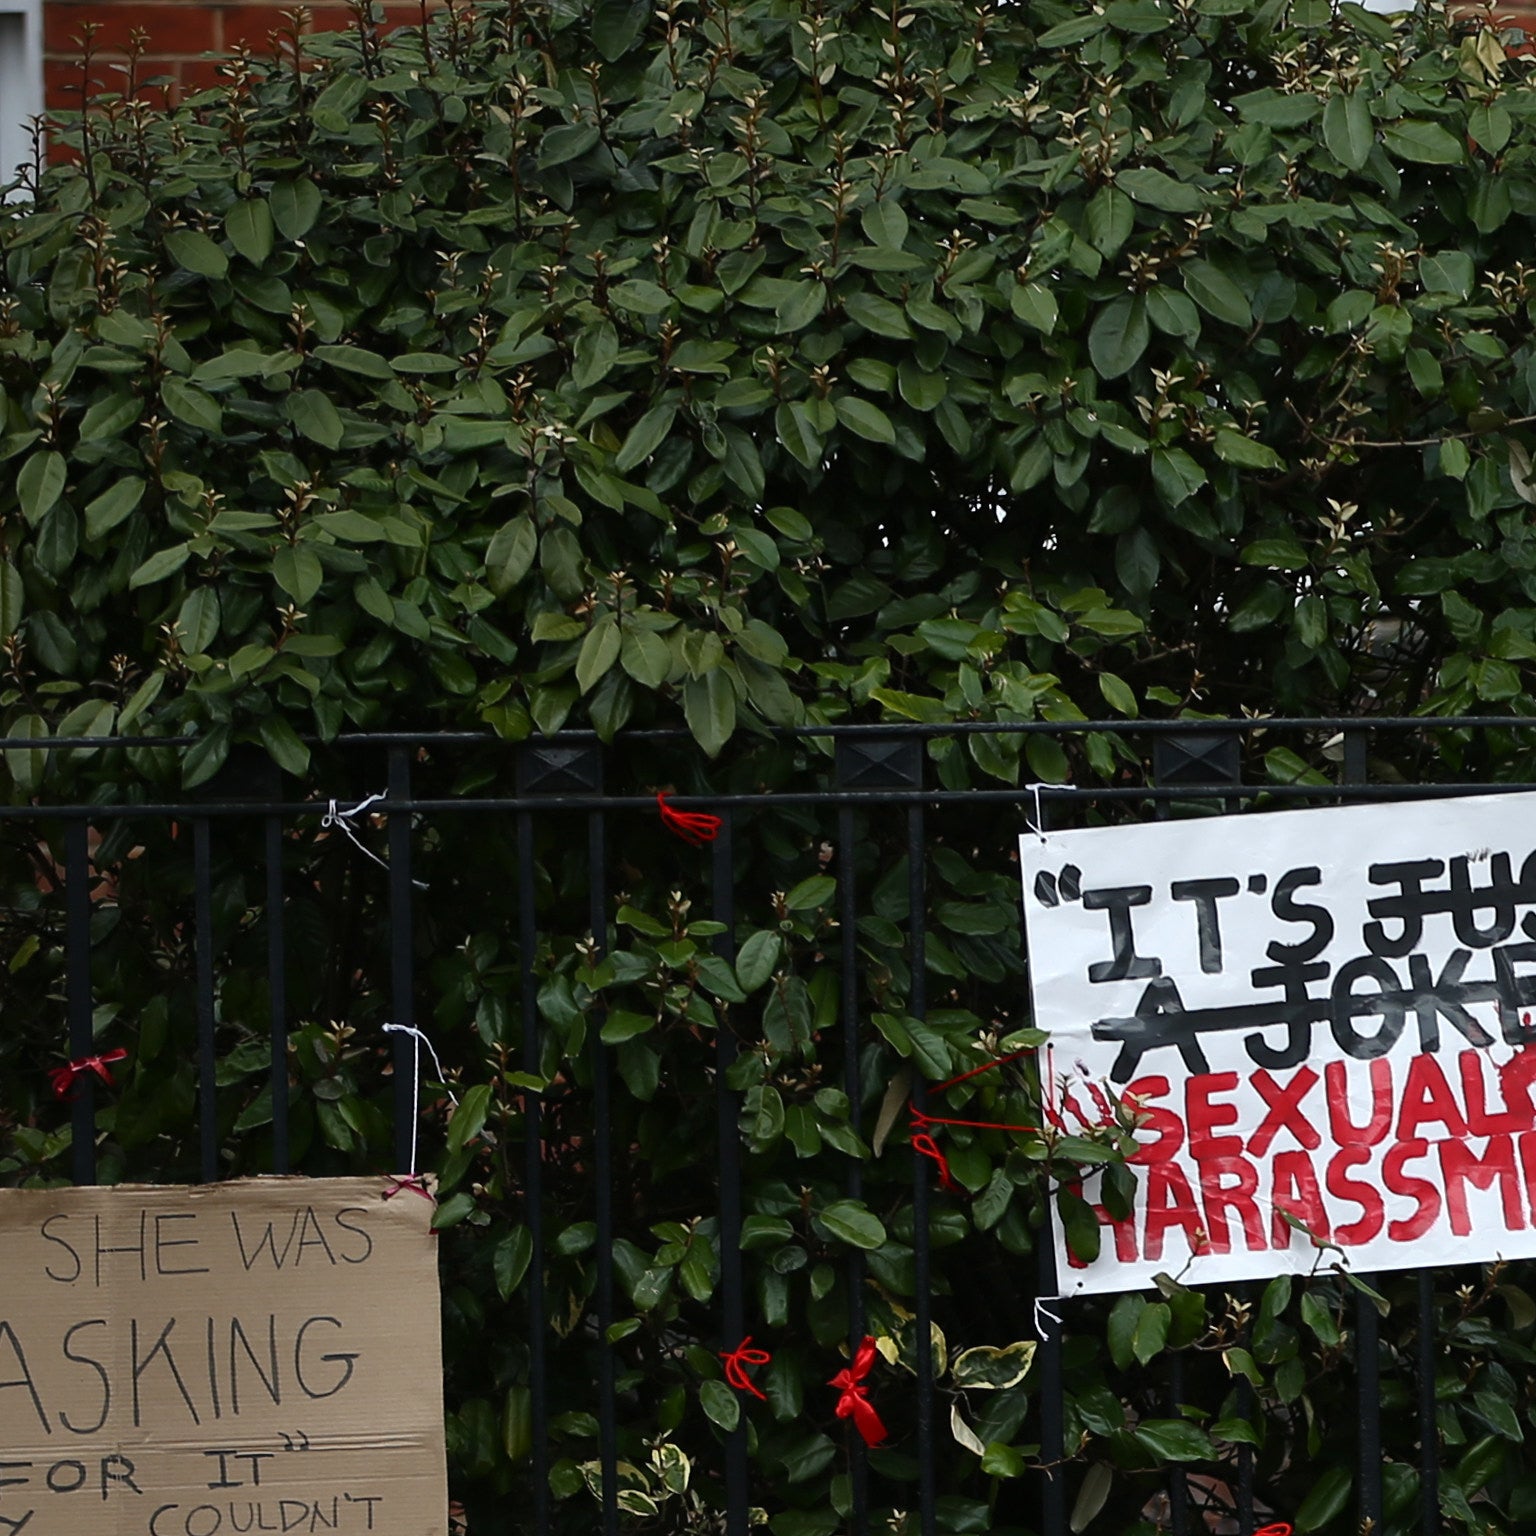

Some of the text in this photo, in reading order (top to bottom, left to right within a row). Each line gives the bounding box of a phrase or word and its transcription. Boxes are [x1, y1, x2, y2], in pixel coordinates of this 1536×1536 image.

[1100, 976, 1211, 1083] A
[1118, 1048, 1536, 1166] SEXUAL
[41, 1205, 374, 1287] SHE WAS
[0, 1313, 362, 1435] ASKING
